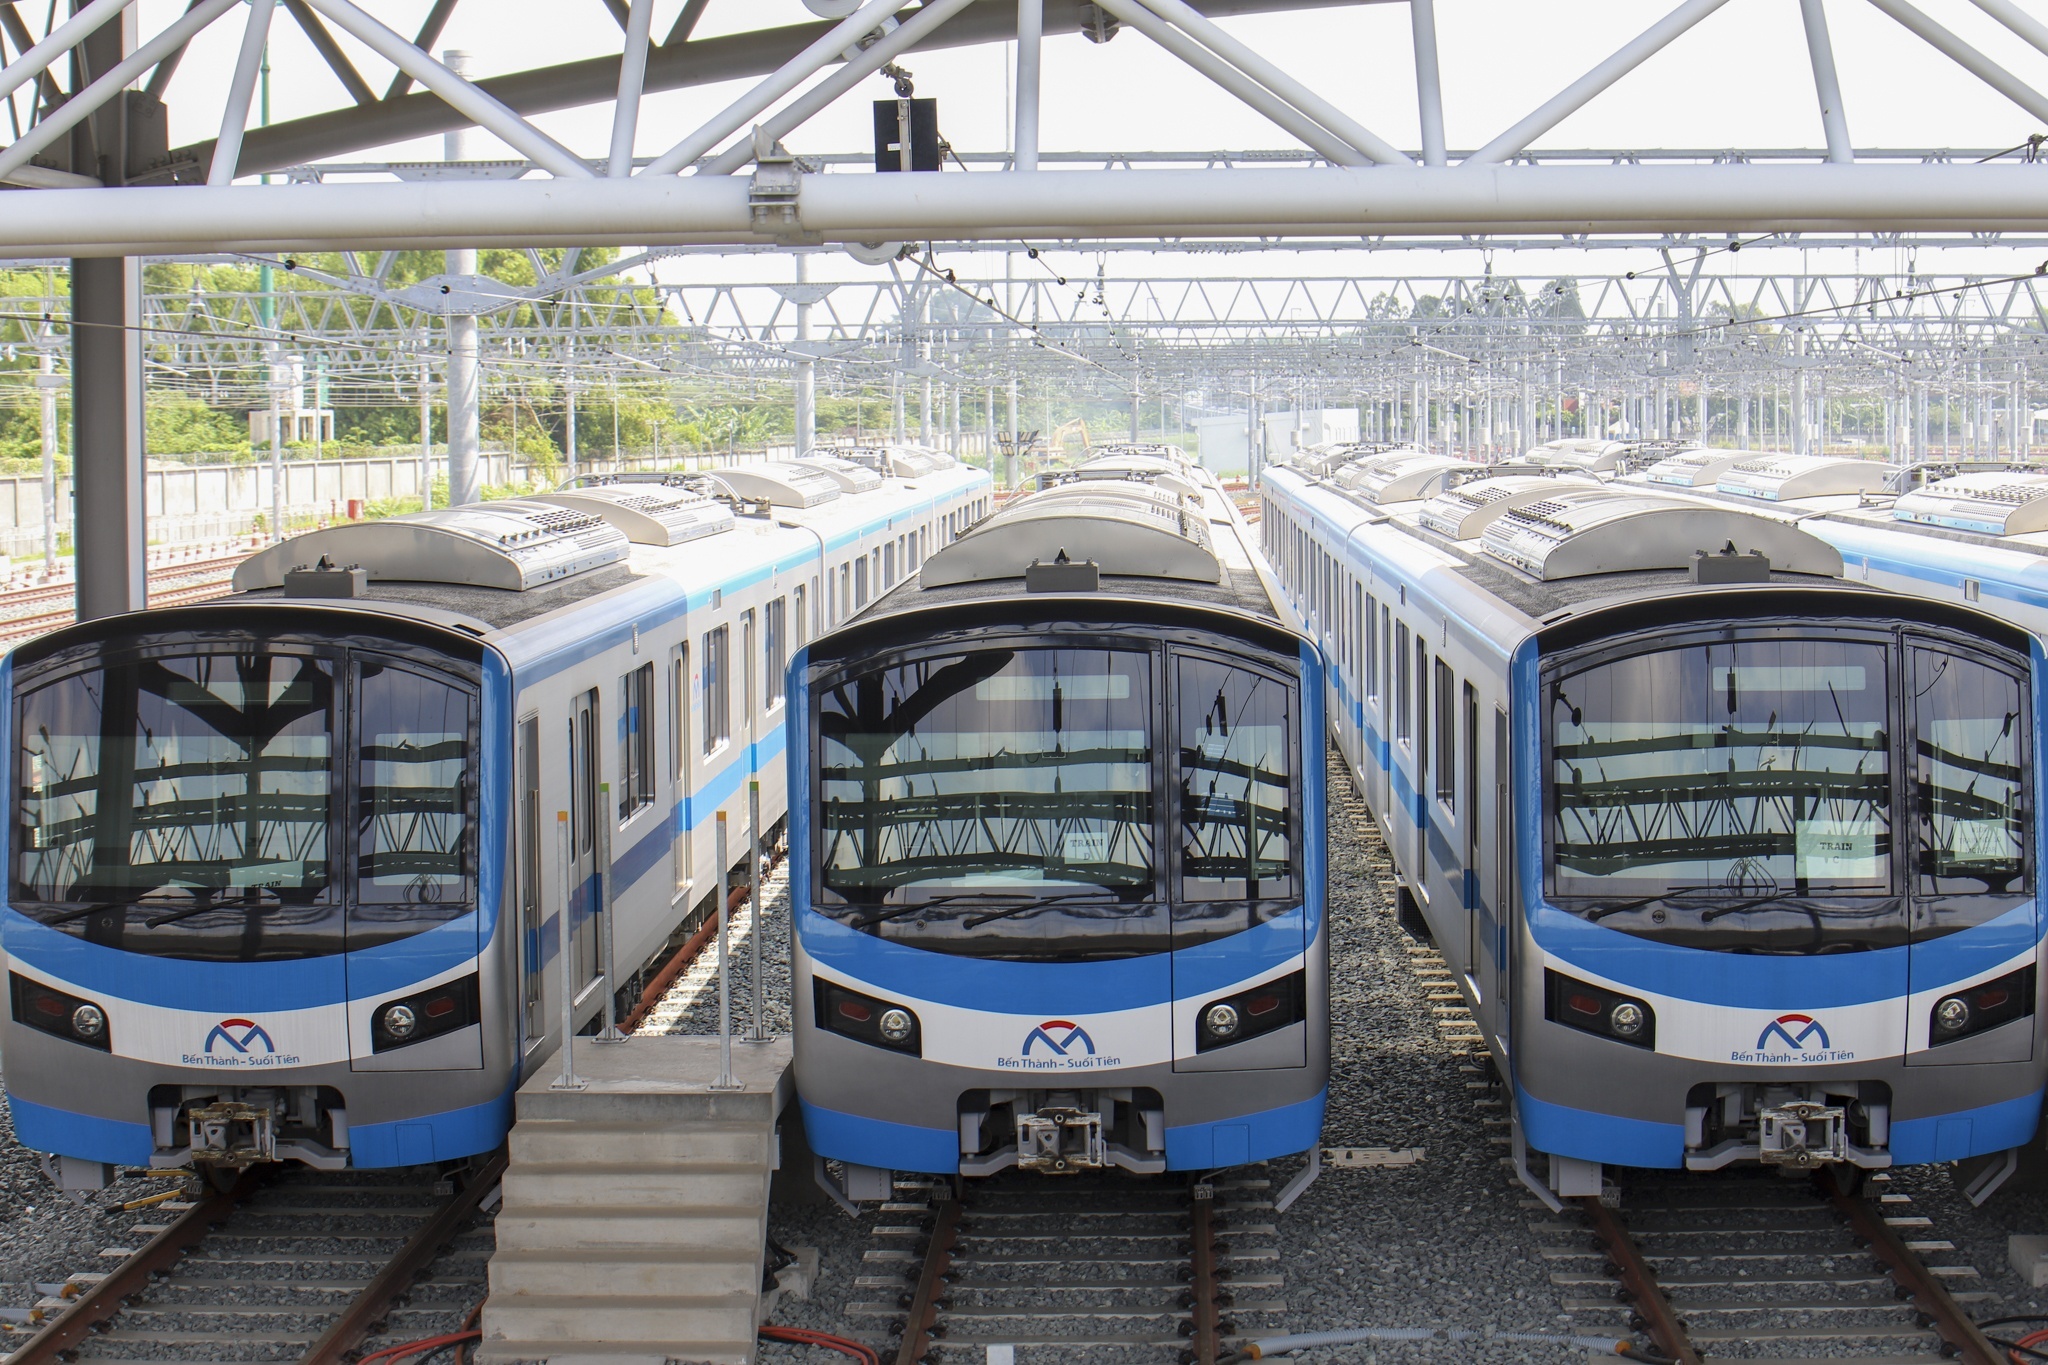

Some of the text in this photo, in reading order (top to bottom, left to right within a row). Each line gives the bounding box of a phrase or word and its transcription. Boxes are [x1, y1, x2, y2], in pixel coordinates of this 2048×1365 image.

[1070, 839, 1103, 847] TRAIN
[1820, 842, 1852, 850] TRAIN
[182, 1053, 203, 1064] Bến
[204, 1055, 238, 1066] Thành
[249, 1054, 274, 1066] Suối
[275, 1053, 300, 1064] Tiên
[997, 1057, 1019, 1067] Bến
[1021, 1058, 1057, 1069] Thành
[1067, 1057, 1094, 1068] Suối
[1095, 1056, 1120, 1067] Tiên
[1731, 1051, 1753, 1062] Bến
[1755, 1052, 1791, 1063] Thành
[1801, 1051, 1827, 1062] Suối
[1829, 1050, 1854, 1060] Tiên
